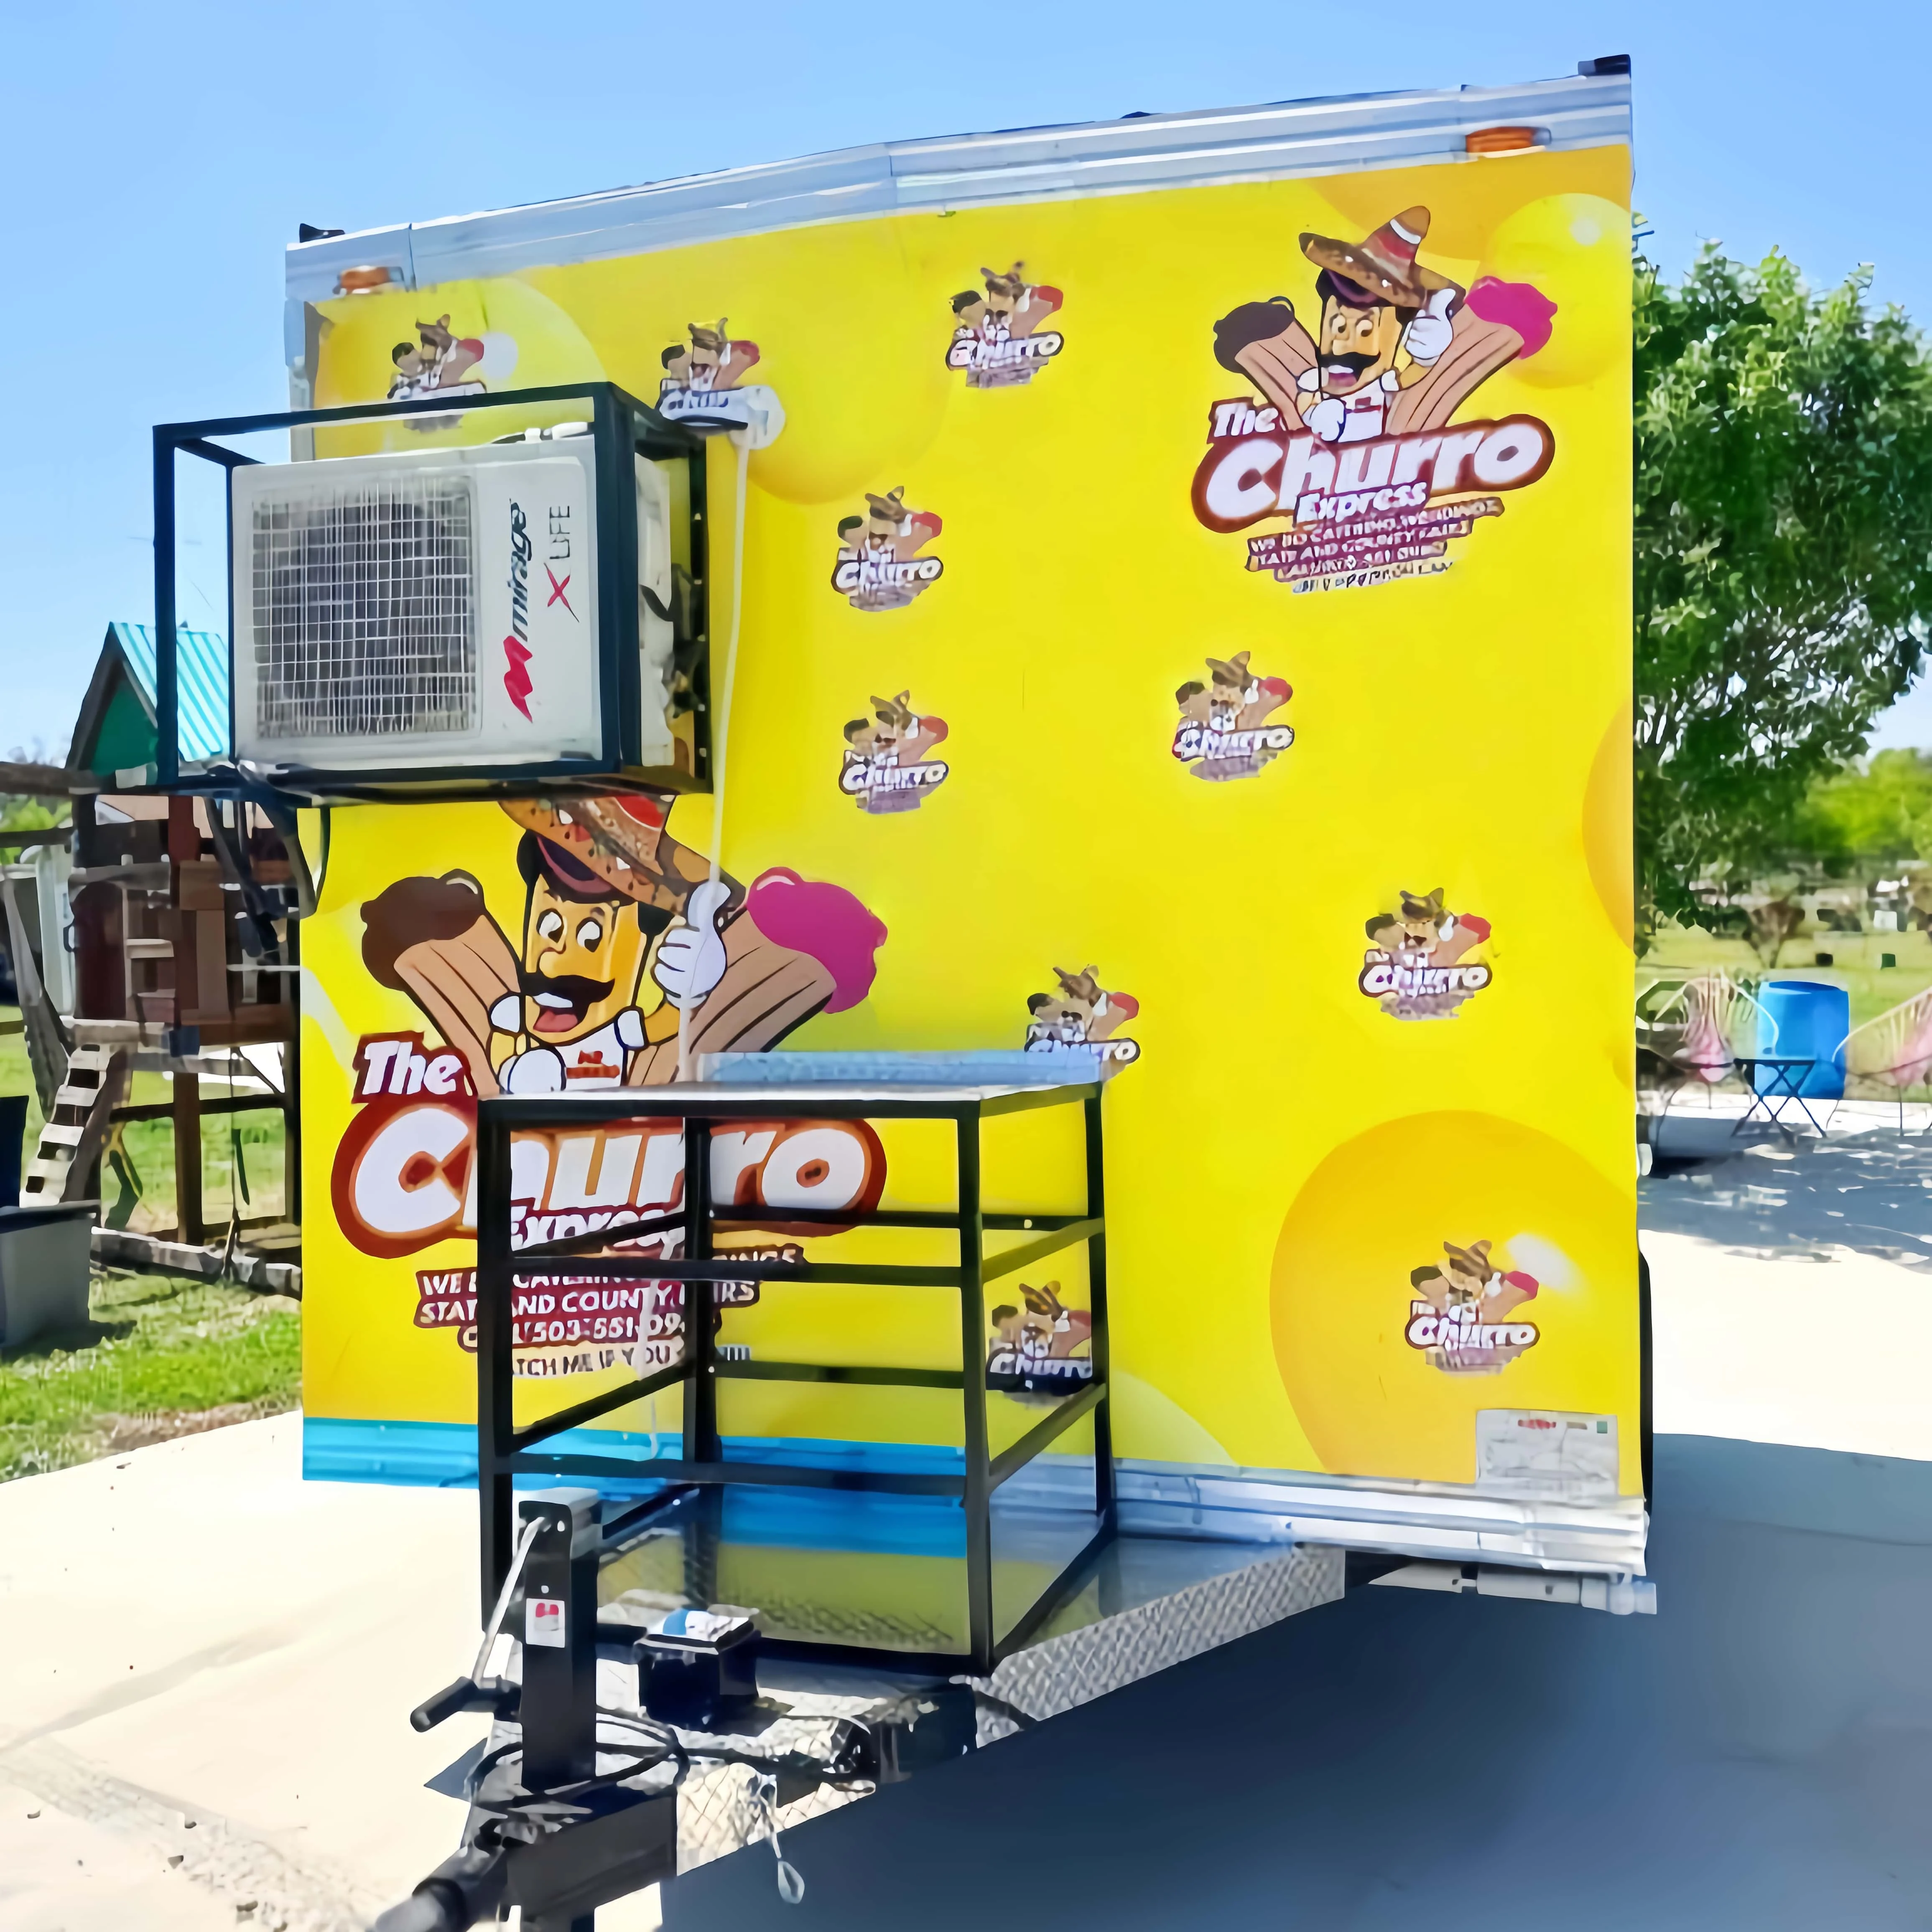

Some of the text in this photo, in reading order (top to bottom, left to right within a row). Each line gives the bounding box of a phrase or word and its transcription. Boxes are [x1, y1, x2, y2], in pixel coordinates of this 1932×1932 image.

[1206, 423, 1544, 520] Churro
[1296, 482, 1427, 523] Express
[362, 1041, 462, 1096] The
[420, 1299, 477, 1323] STAT
[512, 1294, 555, 1318] ND
[562, 1284, 674, 1313] COUNY
[423, 1273, 463, 1295] WE
